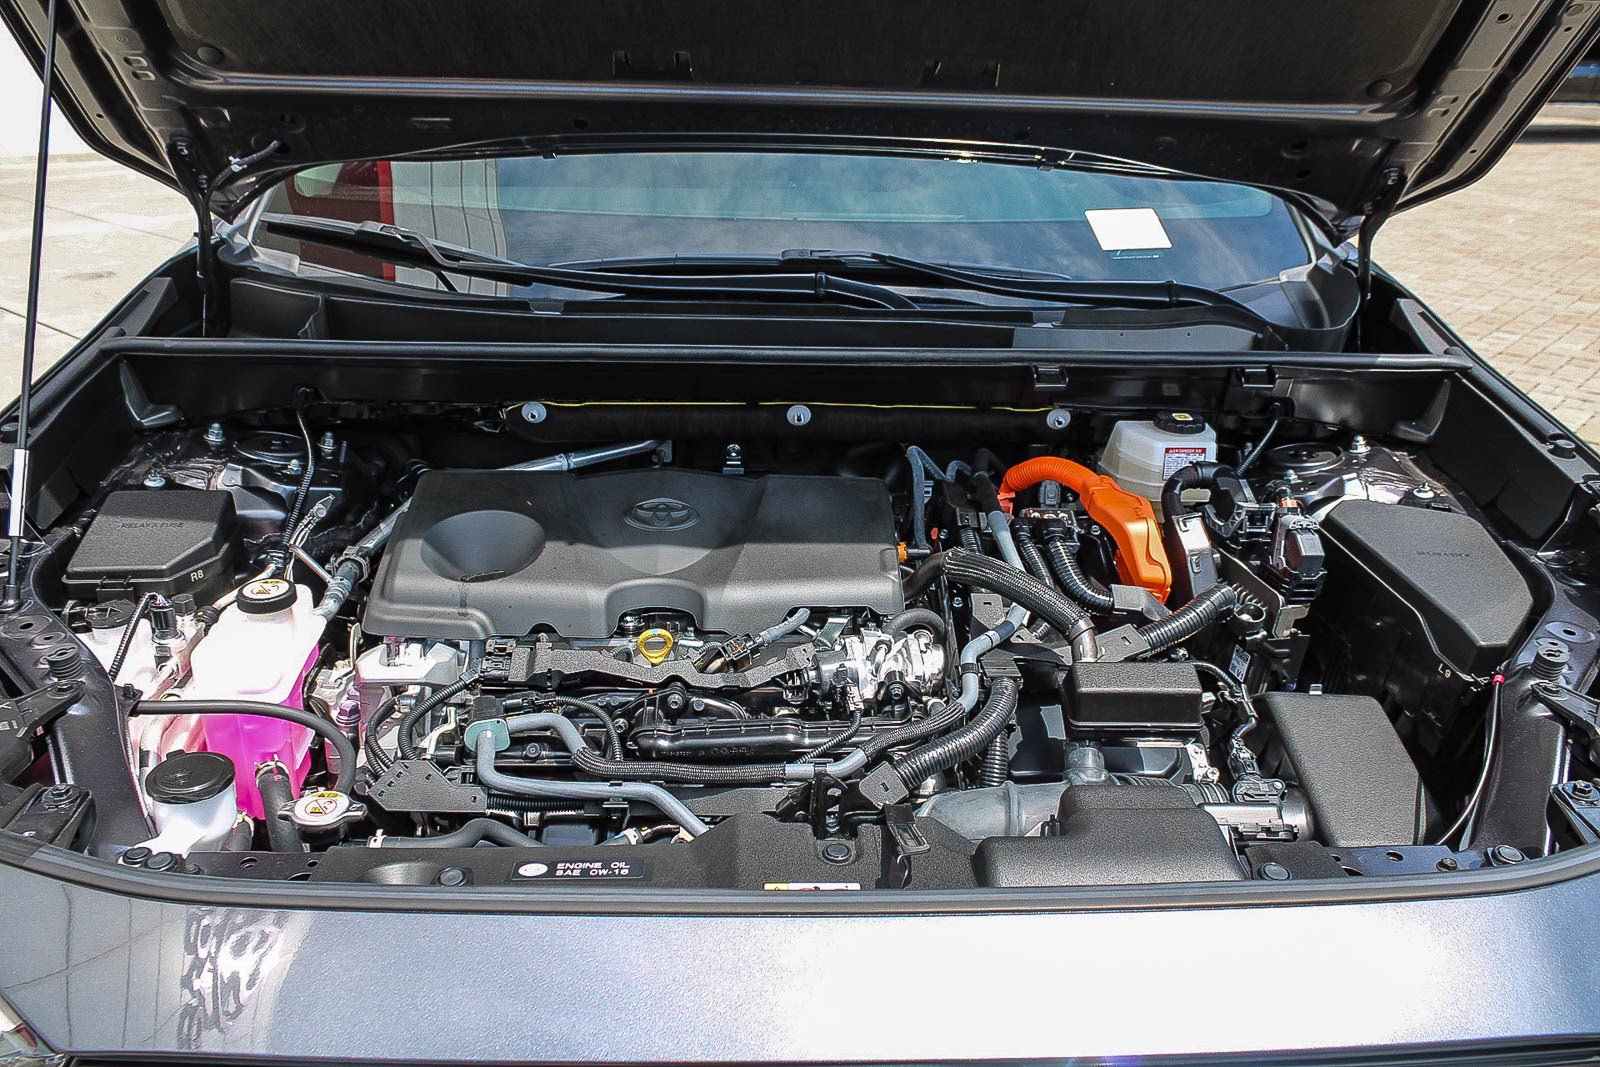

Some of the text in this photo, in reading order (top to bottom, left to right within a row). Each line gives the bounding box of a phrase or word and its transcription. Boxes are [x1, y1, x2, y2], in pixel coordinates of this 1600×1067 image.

[190, 569, 204, 582] R8
[1438, 663, 1451, 678] L9
[610, 861, 631, 869] OIL
